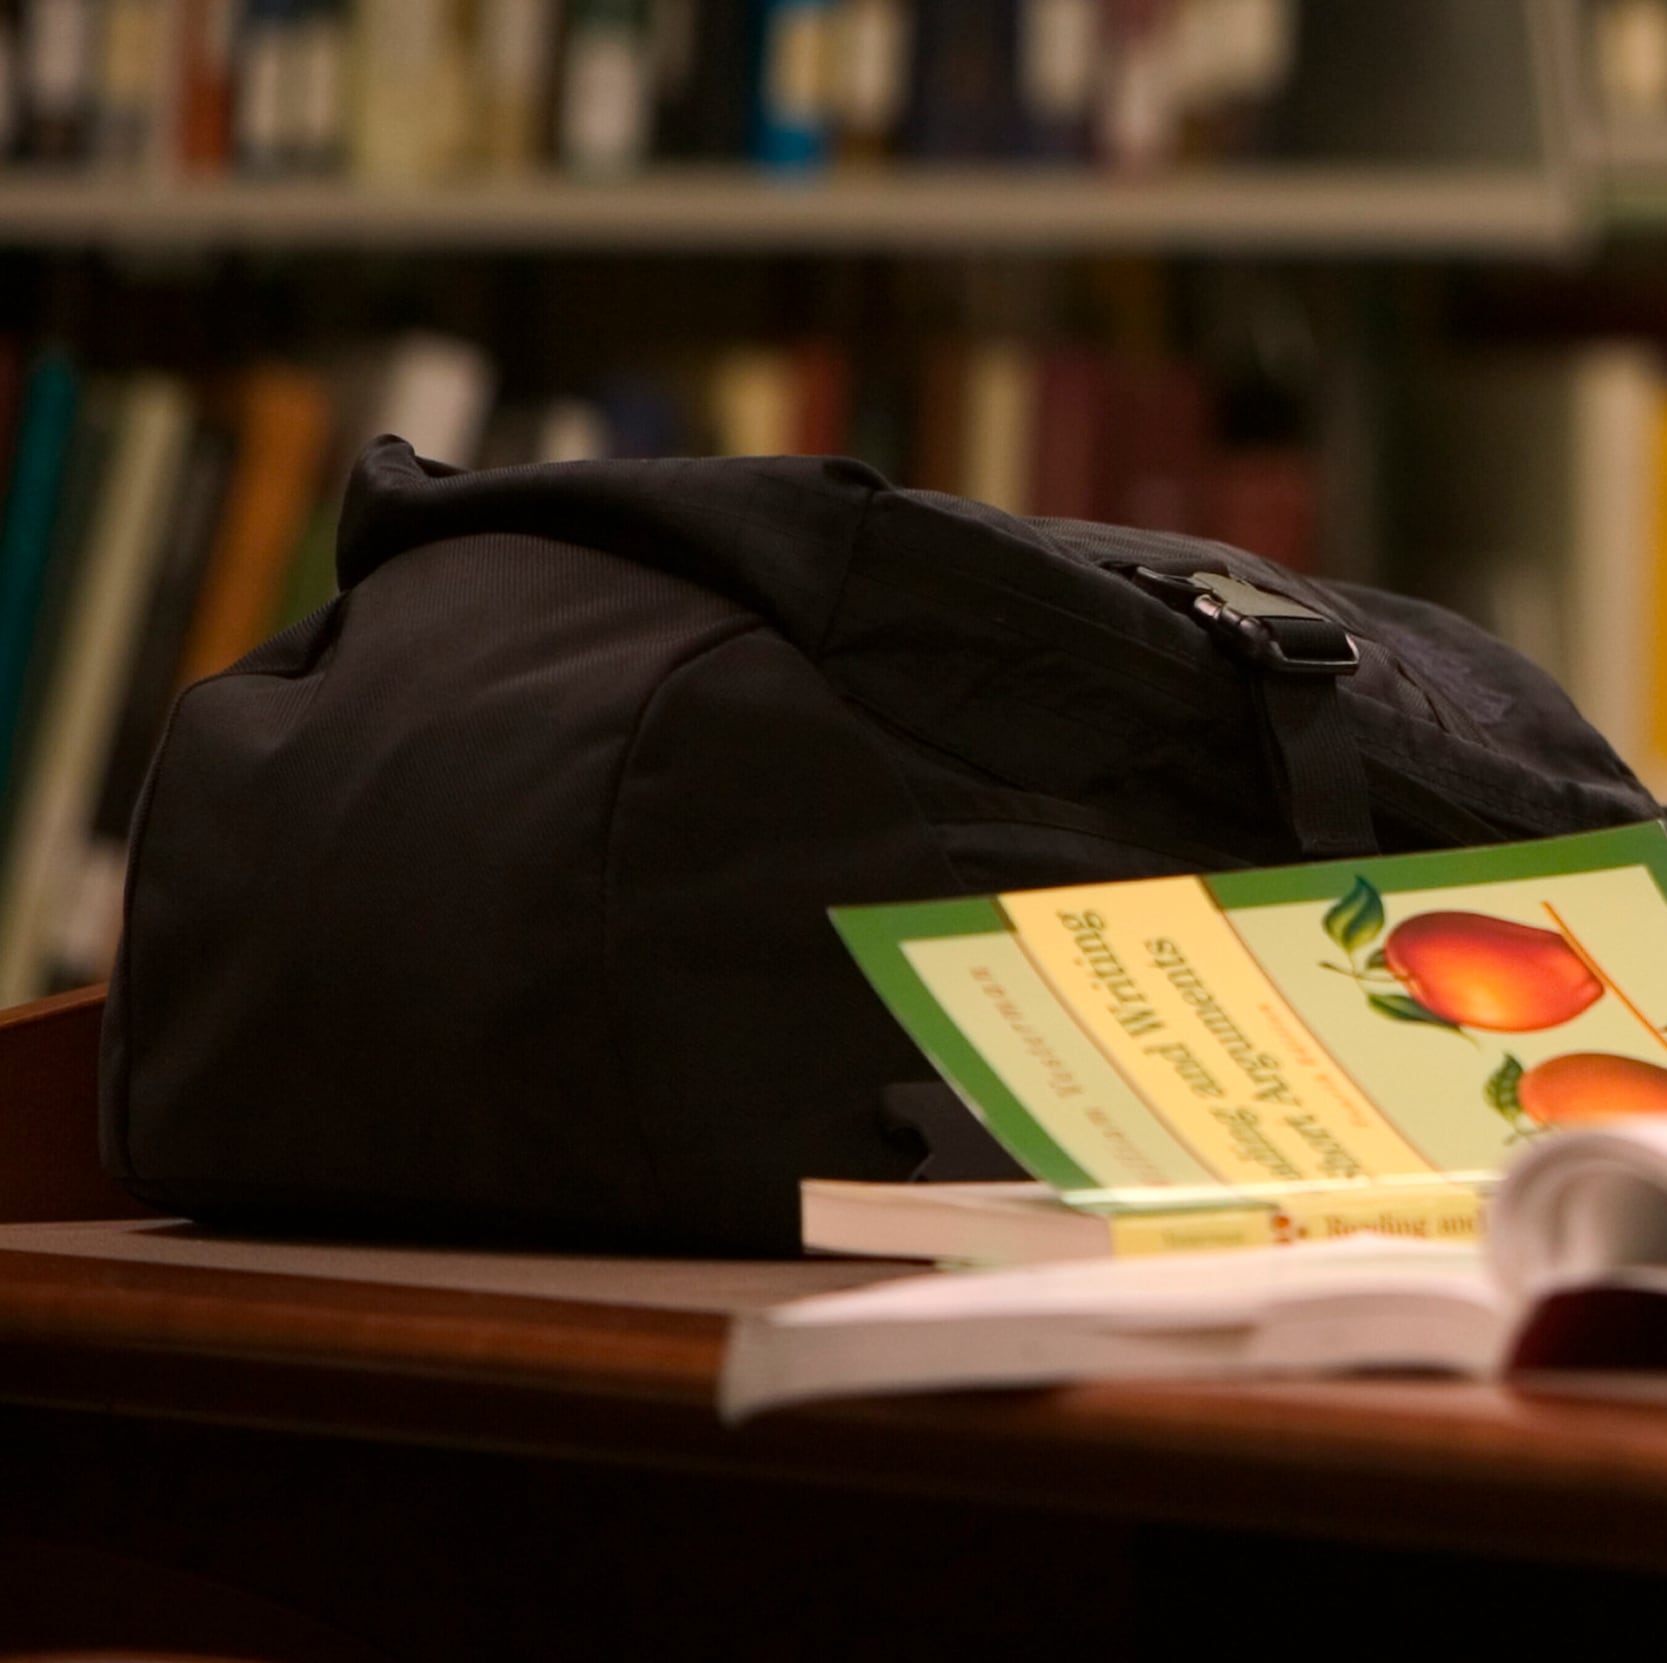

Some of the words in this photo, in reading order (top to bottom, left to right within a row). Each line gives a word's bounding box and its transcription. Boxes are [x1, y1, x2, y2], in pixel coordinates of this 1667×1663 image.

[1056, 909, 1164, 1039] Writing
[1145, 938, 1304, 1108] Arguments
[1142, 1042, 1225, 1099] and
[1207, 1107, 1306, 1182] ading
